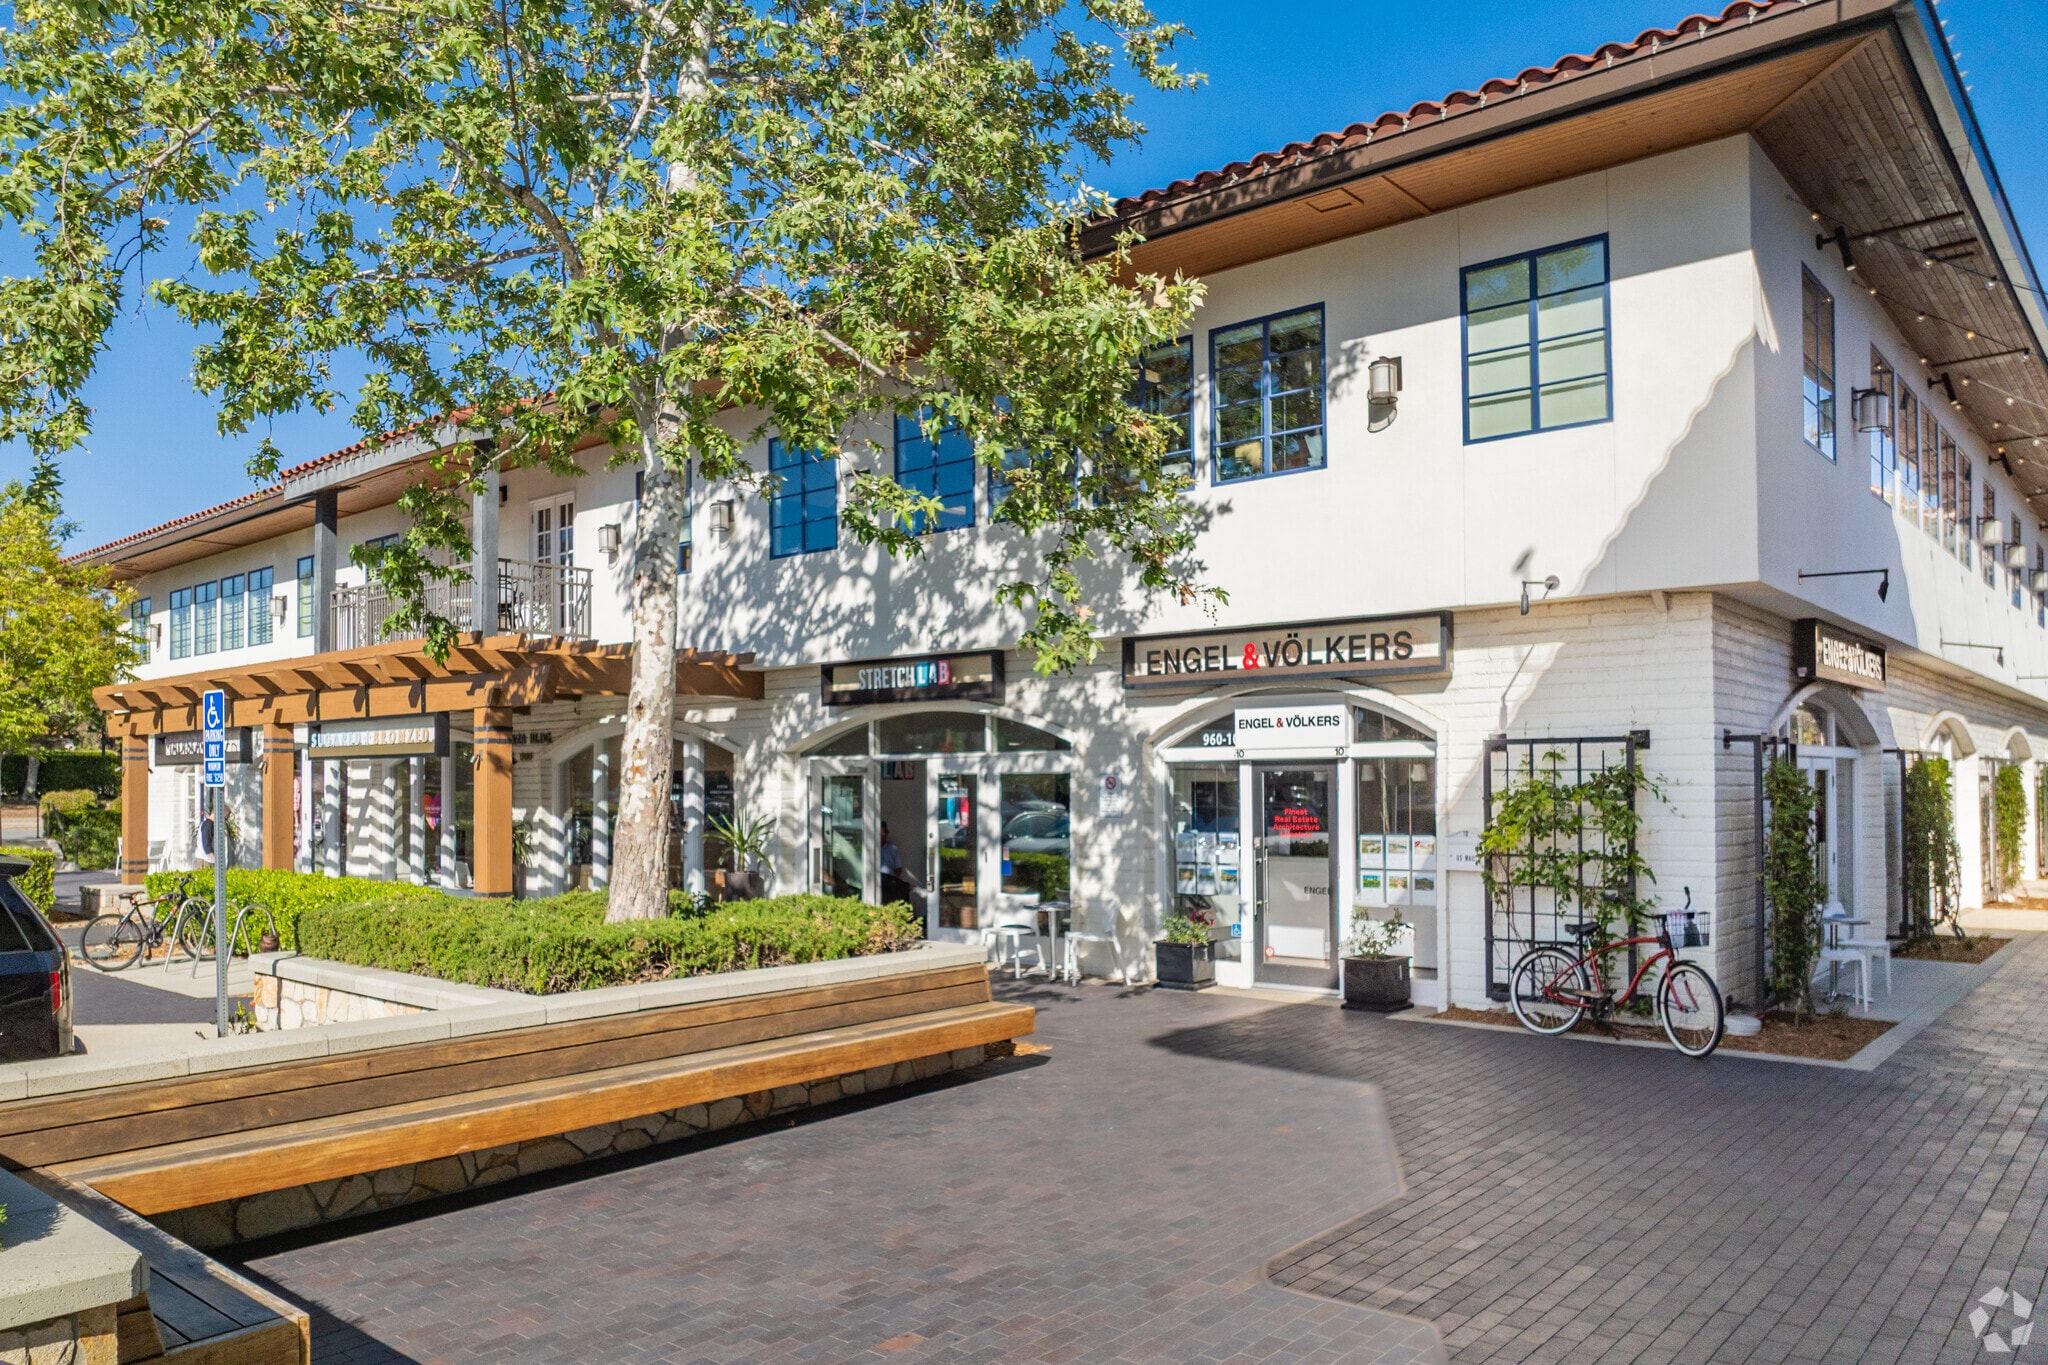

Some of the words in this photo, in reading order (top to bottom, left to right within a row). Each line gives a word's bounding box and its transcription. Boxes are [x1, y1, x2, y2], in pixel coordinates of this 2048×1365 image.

[859, 660, 950, 690] STRETCHLAB
[1238, 718, 1275, 729] ENGEL
[1276, 717, 1284, 728] &
[1285, 715, 1341, 727] VÖLKERS
[205, 729, 223, 742] PARKING
[373, 727, 430, 745] BRONZED
[209, 744, 220, 757] ONLY
